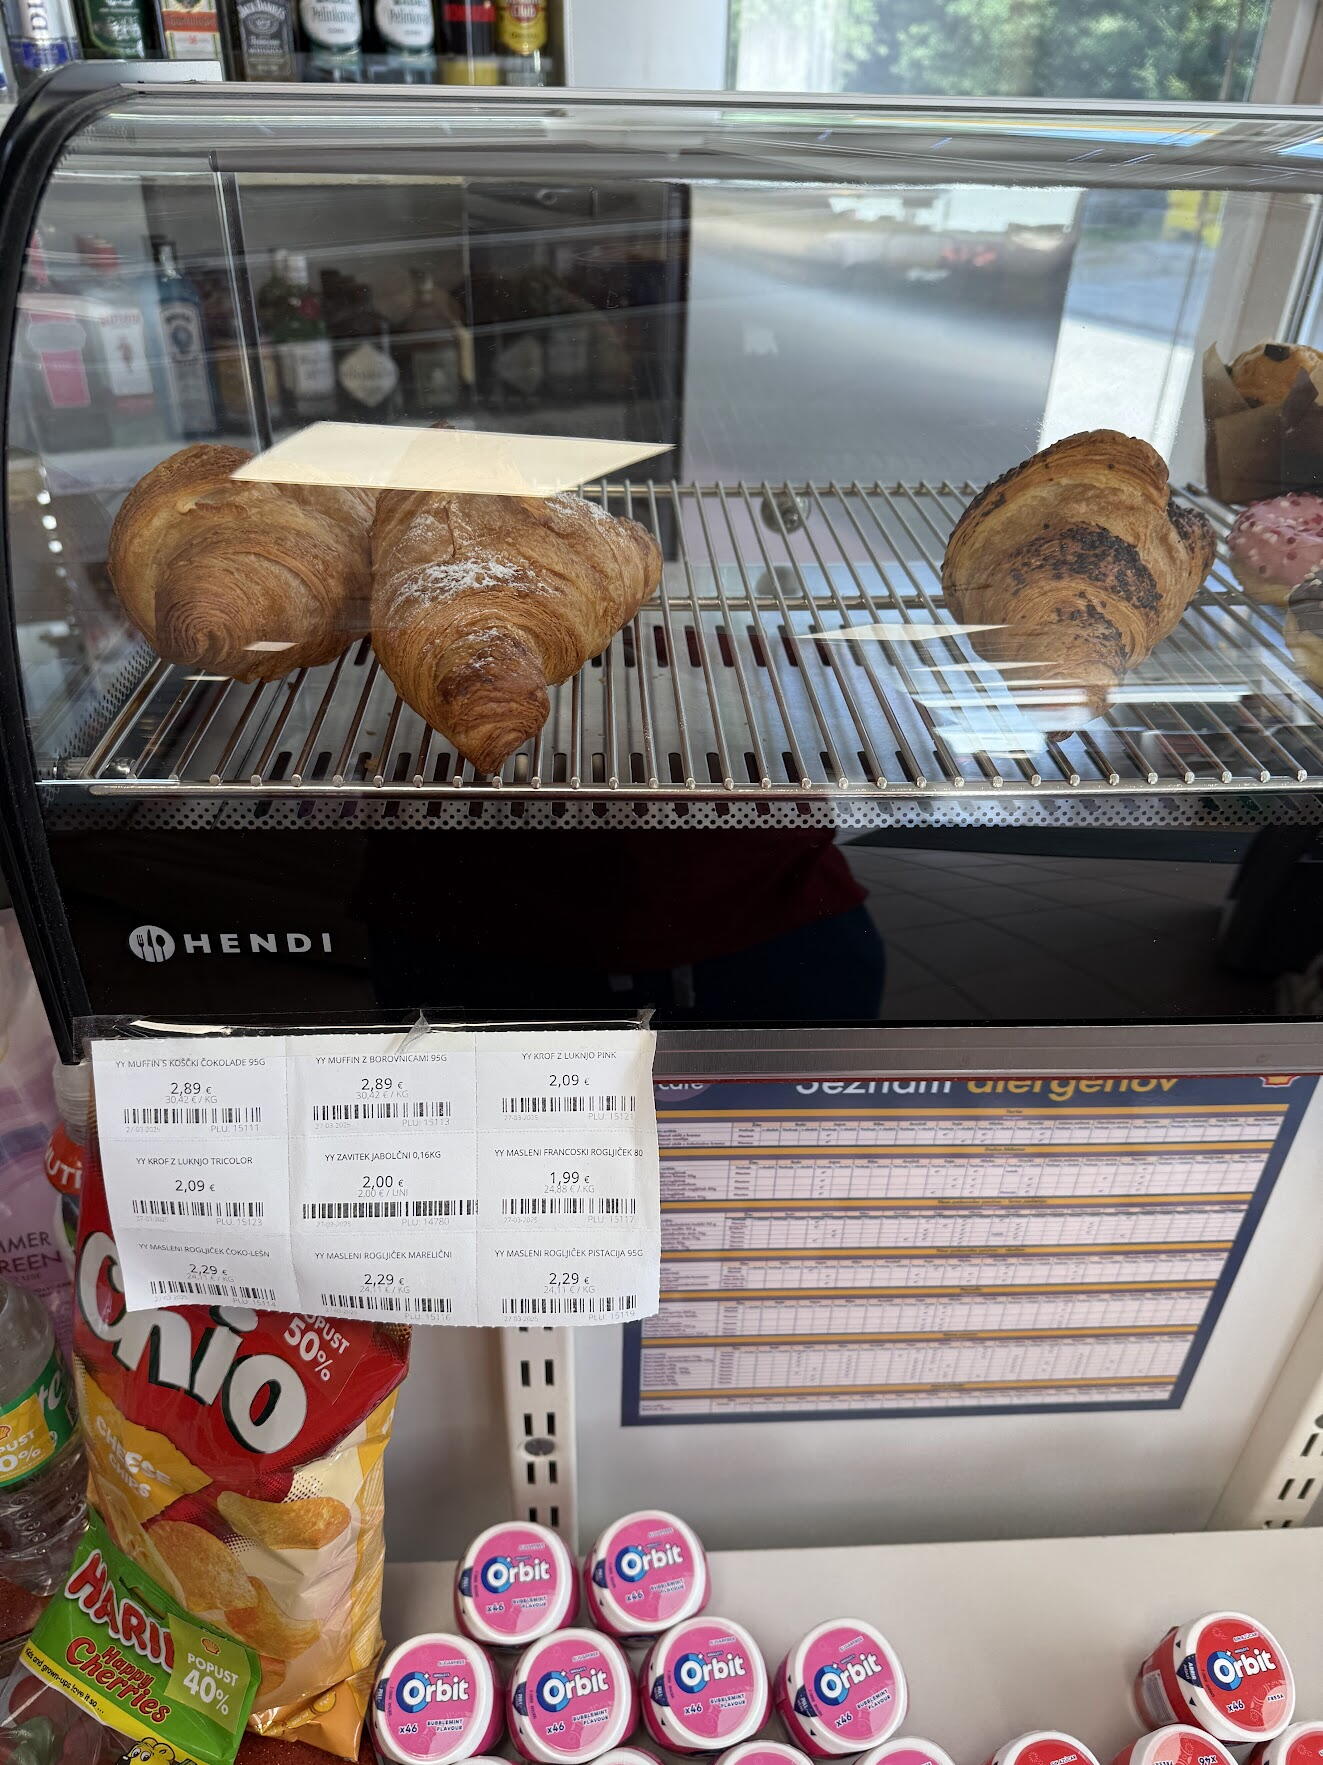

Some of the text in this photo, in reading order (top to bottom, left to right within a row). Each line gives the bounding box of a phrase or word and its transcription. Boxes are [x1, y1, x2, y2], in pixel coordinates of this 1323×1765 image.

[183, 932, 332, 953] HENDI
[115, 1060, 127, 1068] YY
[128, 1059, 160, 1068] MUFFIN
[169, 1057, 199, 1067] KOŠČKI
[201, 1057, 247, 1067] ČOKOLADE
[249, 1058, 265, 1066] 95G
[316, 1054, 447, 1064] YY MUFFIN Z BOROVNICAMI 95G
[522, 1051, 616, 1061] YY KROF Z LUKNJO PINK
[361, 1078, 404, 1092] 2,89 €
[549, 1074, 590, 1088] 2,09 €
[171, 1082, 212, 1096] 2,89 €
[325, 1150, 441, 1162] YY ZAVITEK JABOLČNI 0,16KG
[494, 1146, 643, 1158] YY MASLENI FRANCOSKI ROGLJIČEK 80
[136, 1156, 253, 1166] YY KROF Z LUKNJO TRICOLOR
[362, 1175, 404, 1190] 2,00 €
[550, 1171, 590, 1186] 1,99 €
[175, 1179, 216, 1193] 2,09 €
[150, 1244, 183, 1252] MASLENI
[315, 1249, 452, 1261] YY MASLENI ROGLJIČEK MARELIČNI
[506, 1249, 541, 1257] MASLENI
[544, 1247, 587, 1259] ROGLJIČEK
[588, 1249, 626, 1258] PISTACIJA
[627, 1249, 643, 1257] 95G
[189, 1263, 217, 1276] 2,29
[364, 1273, 405, 1287] 2,29 €
[549, 1272, 590, 1287] 2,29 €
[283, 1316, 333, 1381] 50%
[621, 1543, 683, 1576] Orbit
[486, 1558, 550, 1588] Orbit
[626, 1590, 644, 1601] x46
[64, 1549, 174, 1674] HARI
[487, 1603, 504, 1613] x46
[99, 1645, 155, 1689] Happy
[187, 1652, 240, 1688] POPUST
[680, 1653, 746, 1686] Orbit
[1213, 1648, 1276, 1684] Orbit
[32, 1656, 44, 1667] and
[40, 1664, 72, 1689] grown-ups
[71, 1685, 85, 1698] love
[88, 1698, 98, 1708] so
[65, 1637, 172, 1723] Cherries
[820, 1653, 882, 1699] Orbit
[182, 1669, 230, 1716] 40%
[402, 1676, 469, 1706] Orbit
[542, 1668, 609, 1705] Orbit
[685, 1704, 703, 1714] x46
[1227, 1700, 1244, 1712] x46
[836, 1713, 853, 1727] x46
[400, 1724, 418, 1734] x46
[547, 1722, 565, 1734] x46
